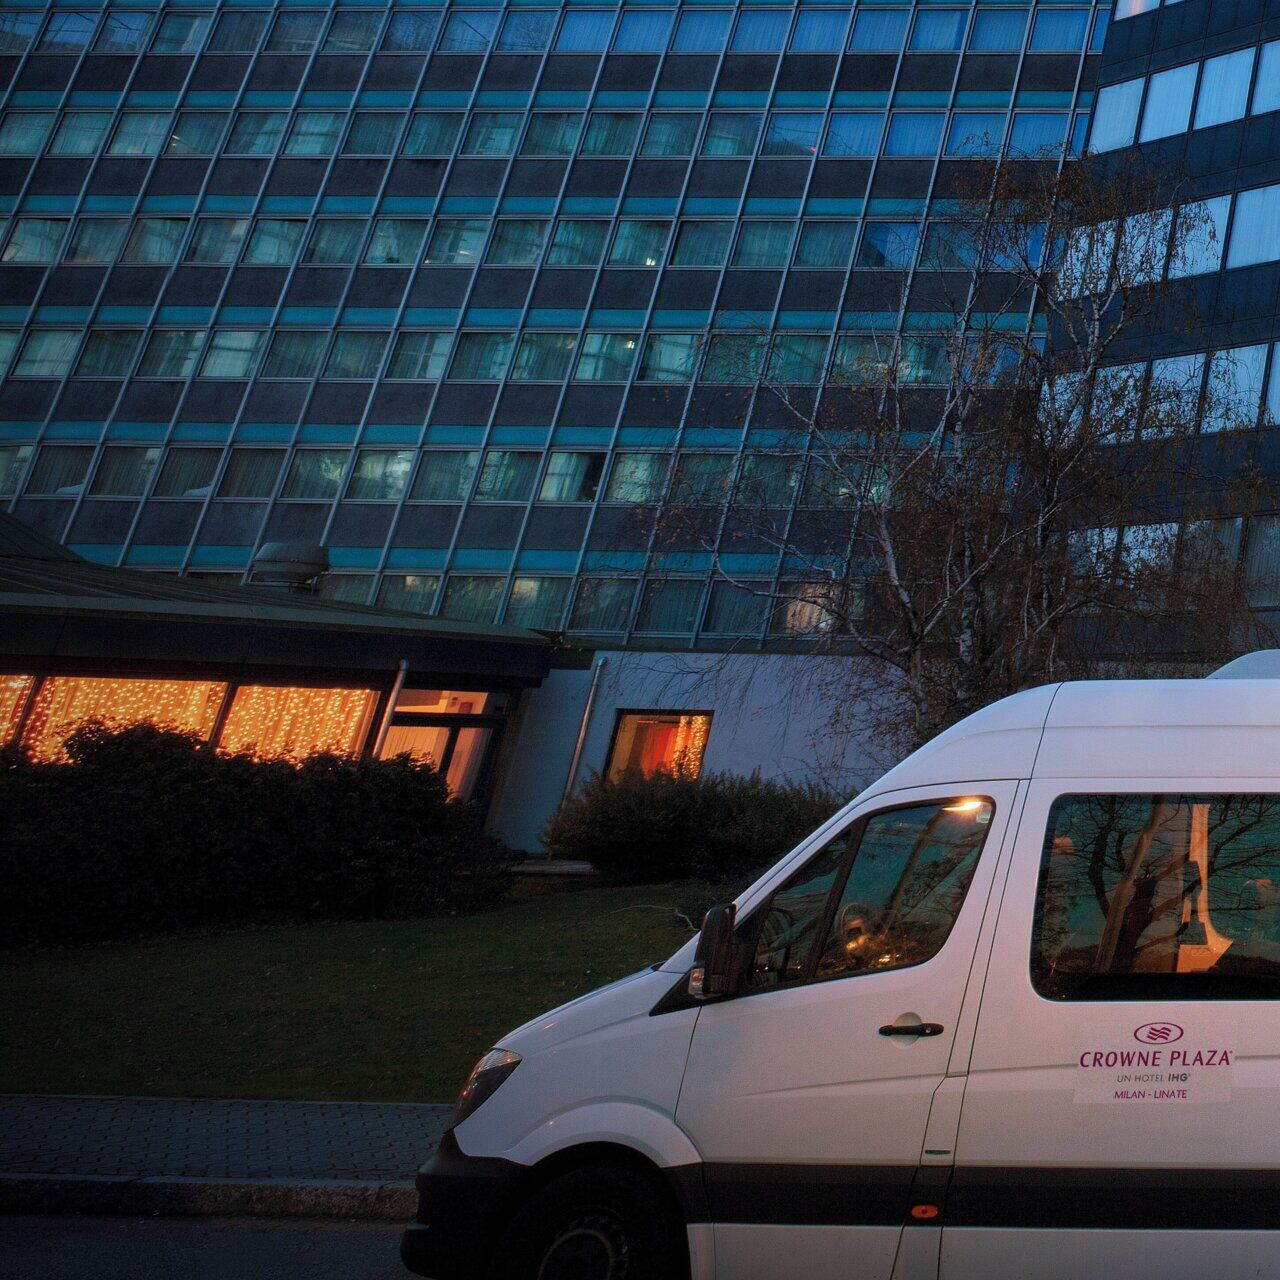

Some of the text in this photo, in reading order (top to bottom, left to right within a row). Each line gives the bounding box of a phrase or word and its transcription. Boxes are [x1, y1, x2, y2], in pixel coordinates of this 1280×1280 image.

[1079, 1049, 1231, 1068] CROWNE PLAZA
[1116, 1072, 1188, 1083] UN HOTEL IHG
[1114, 1089, 1146, 1100] MILAN
[1153, 1089, 1187, 1100] LINATE
